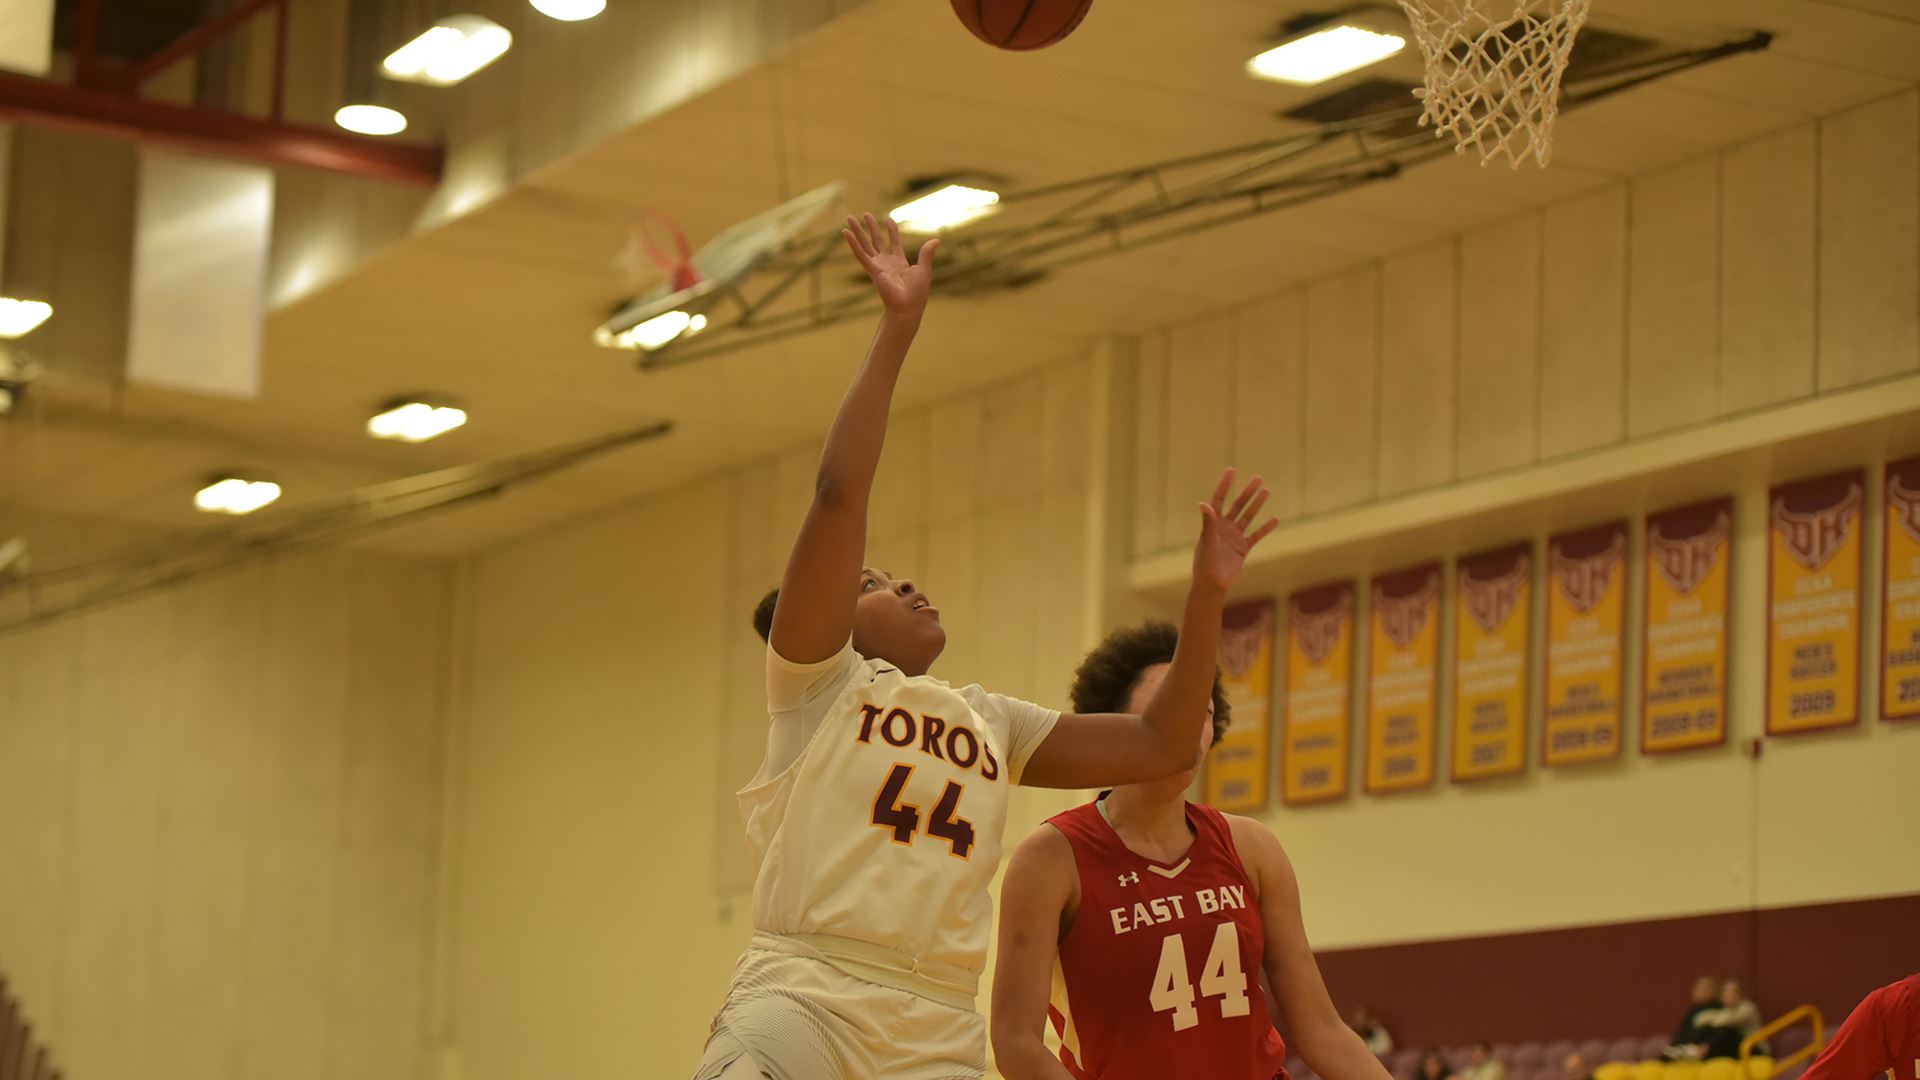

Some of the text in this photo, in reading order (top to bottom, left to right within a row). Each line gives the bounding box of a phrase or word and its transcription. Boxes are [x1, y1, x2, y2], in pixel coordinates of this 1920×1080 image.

[1773, 589, 1855, 619] CONFERENCE
[1790, 690, 1835, 718] 2009
[855, 703, 999, 781] TOROS
[870, 761, 976, 862] 44
[1110, 885, 1246, 935] EAST BAY
[1149, 921, 1250, 1032] 44
